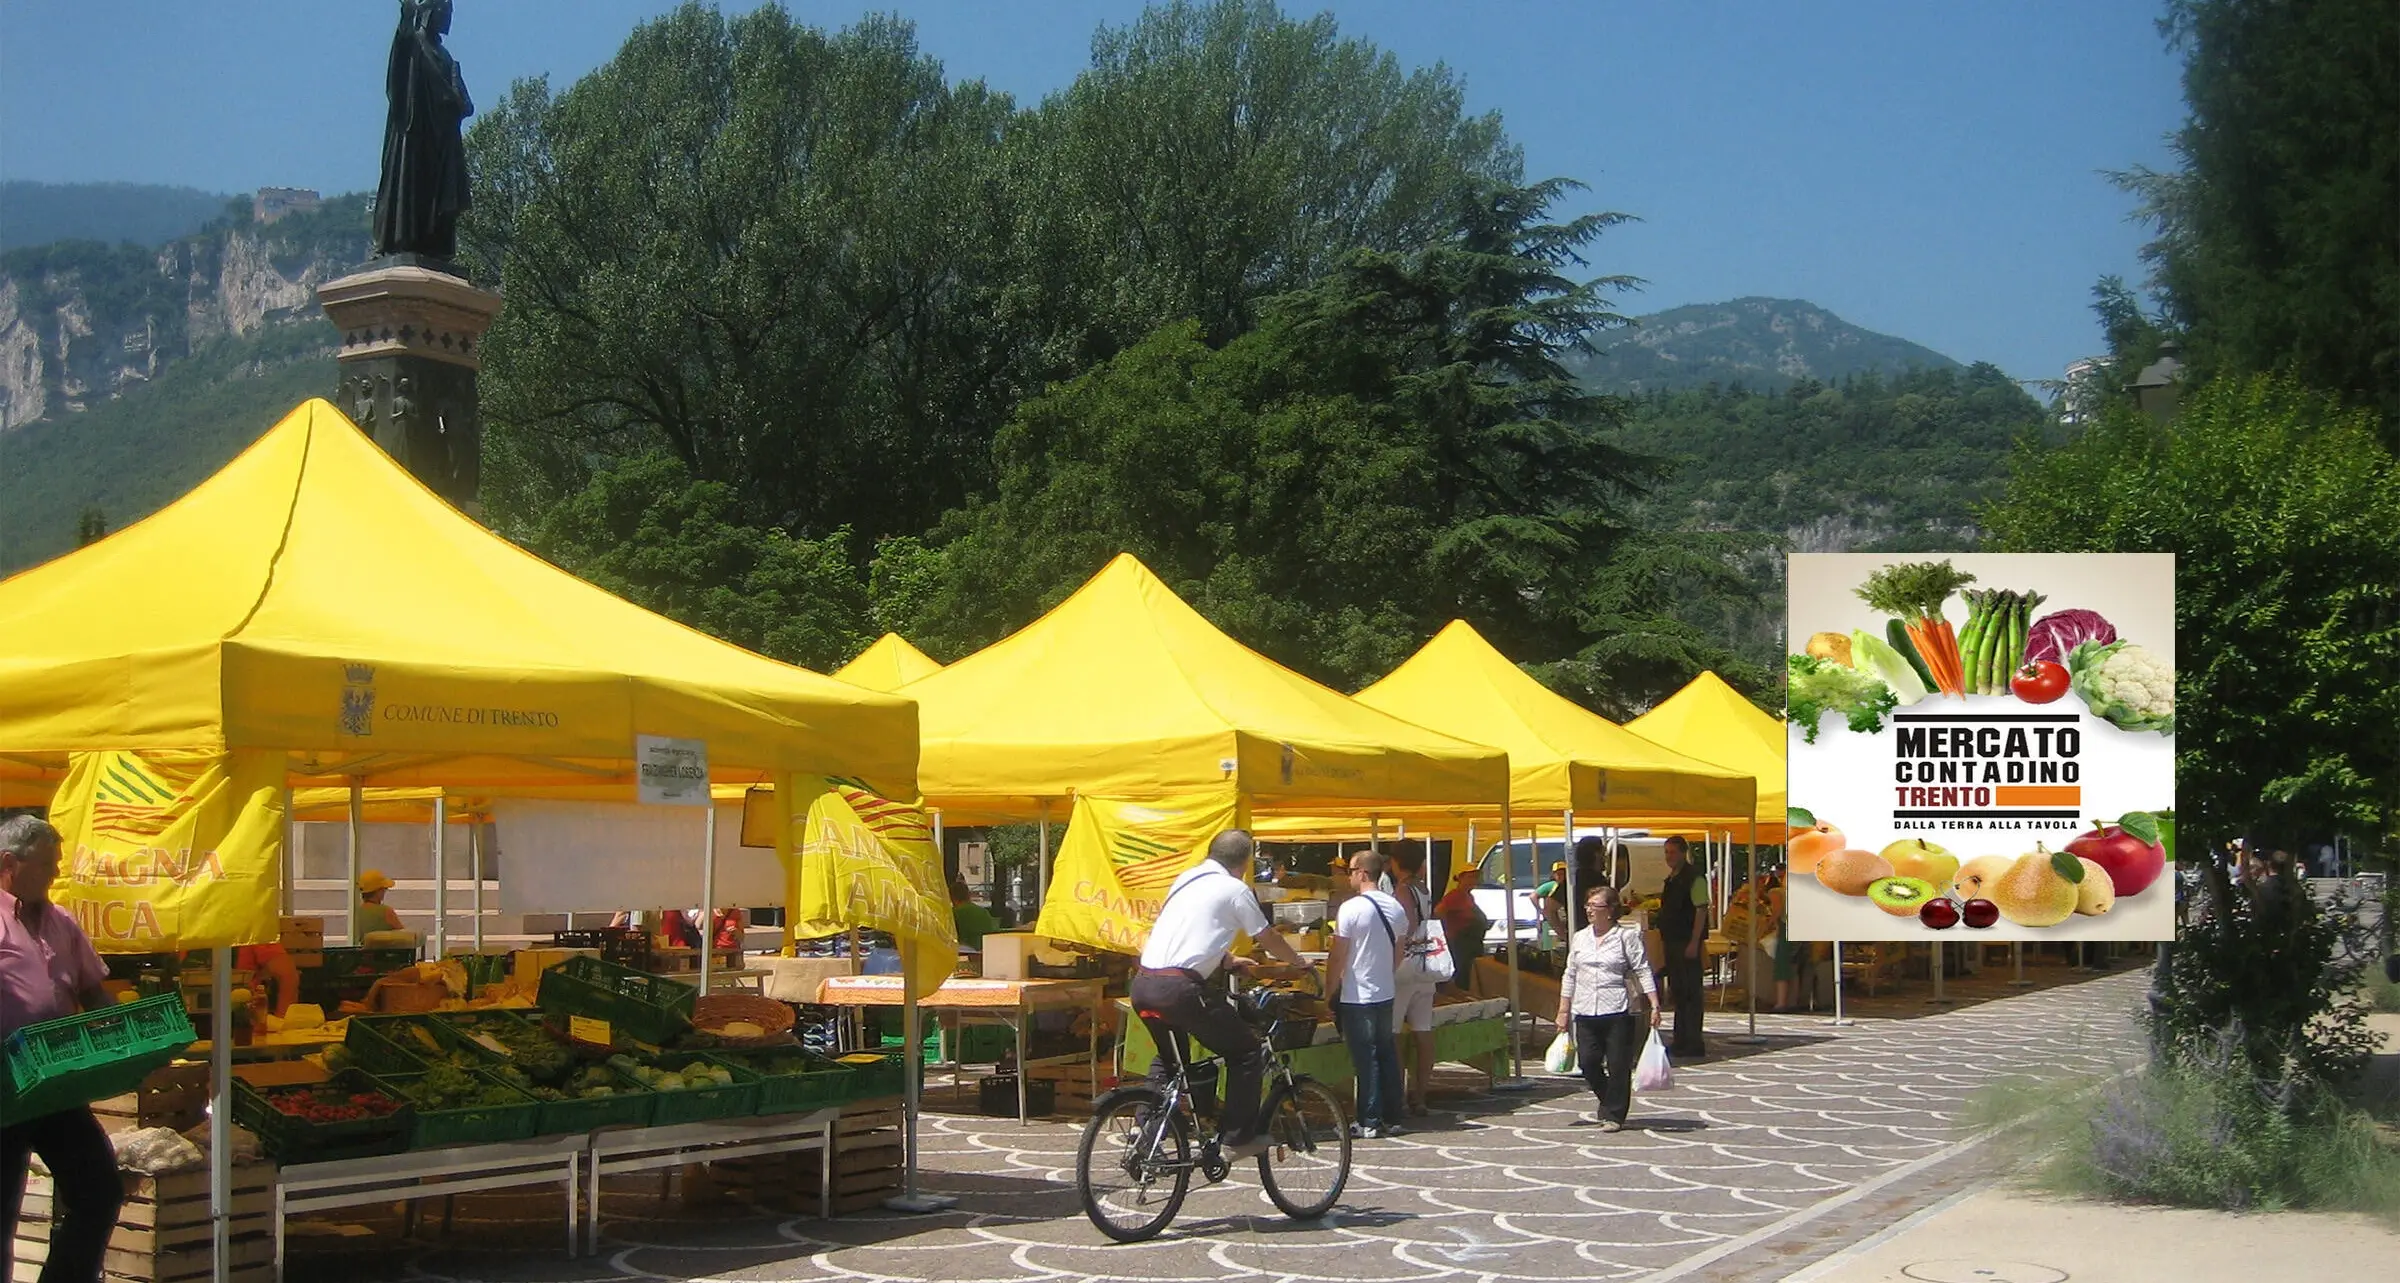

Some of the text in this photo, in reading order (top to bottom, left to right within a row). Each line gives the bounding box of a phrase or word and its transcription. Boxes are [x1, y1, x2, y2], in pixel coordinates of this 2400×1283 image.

[384, 704, 559, 729] COMUNE DI TRENTO
